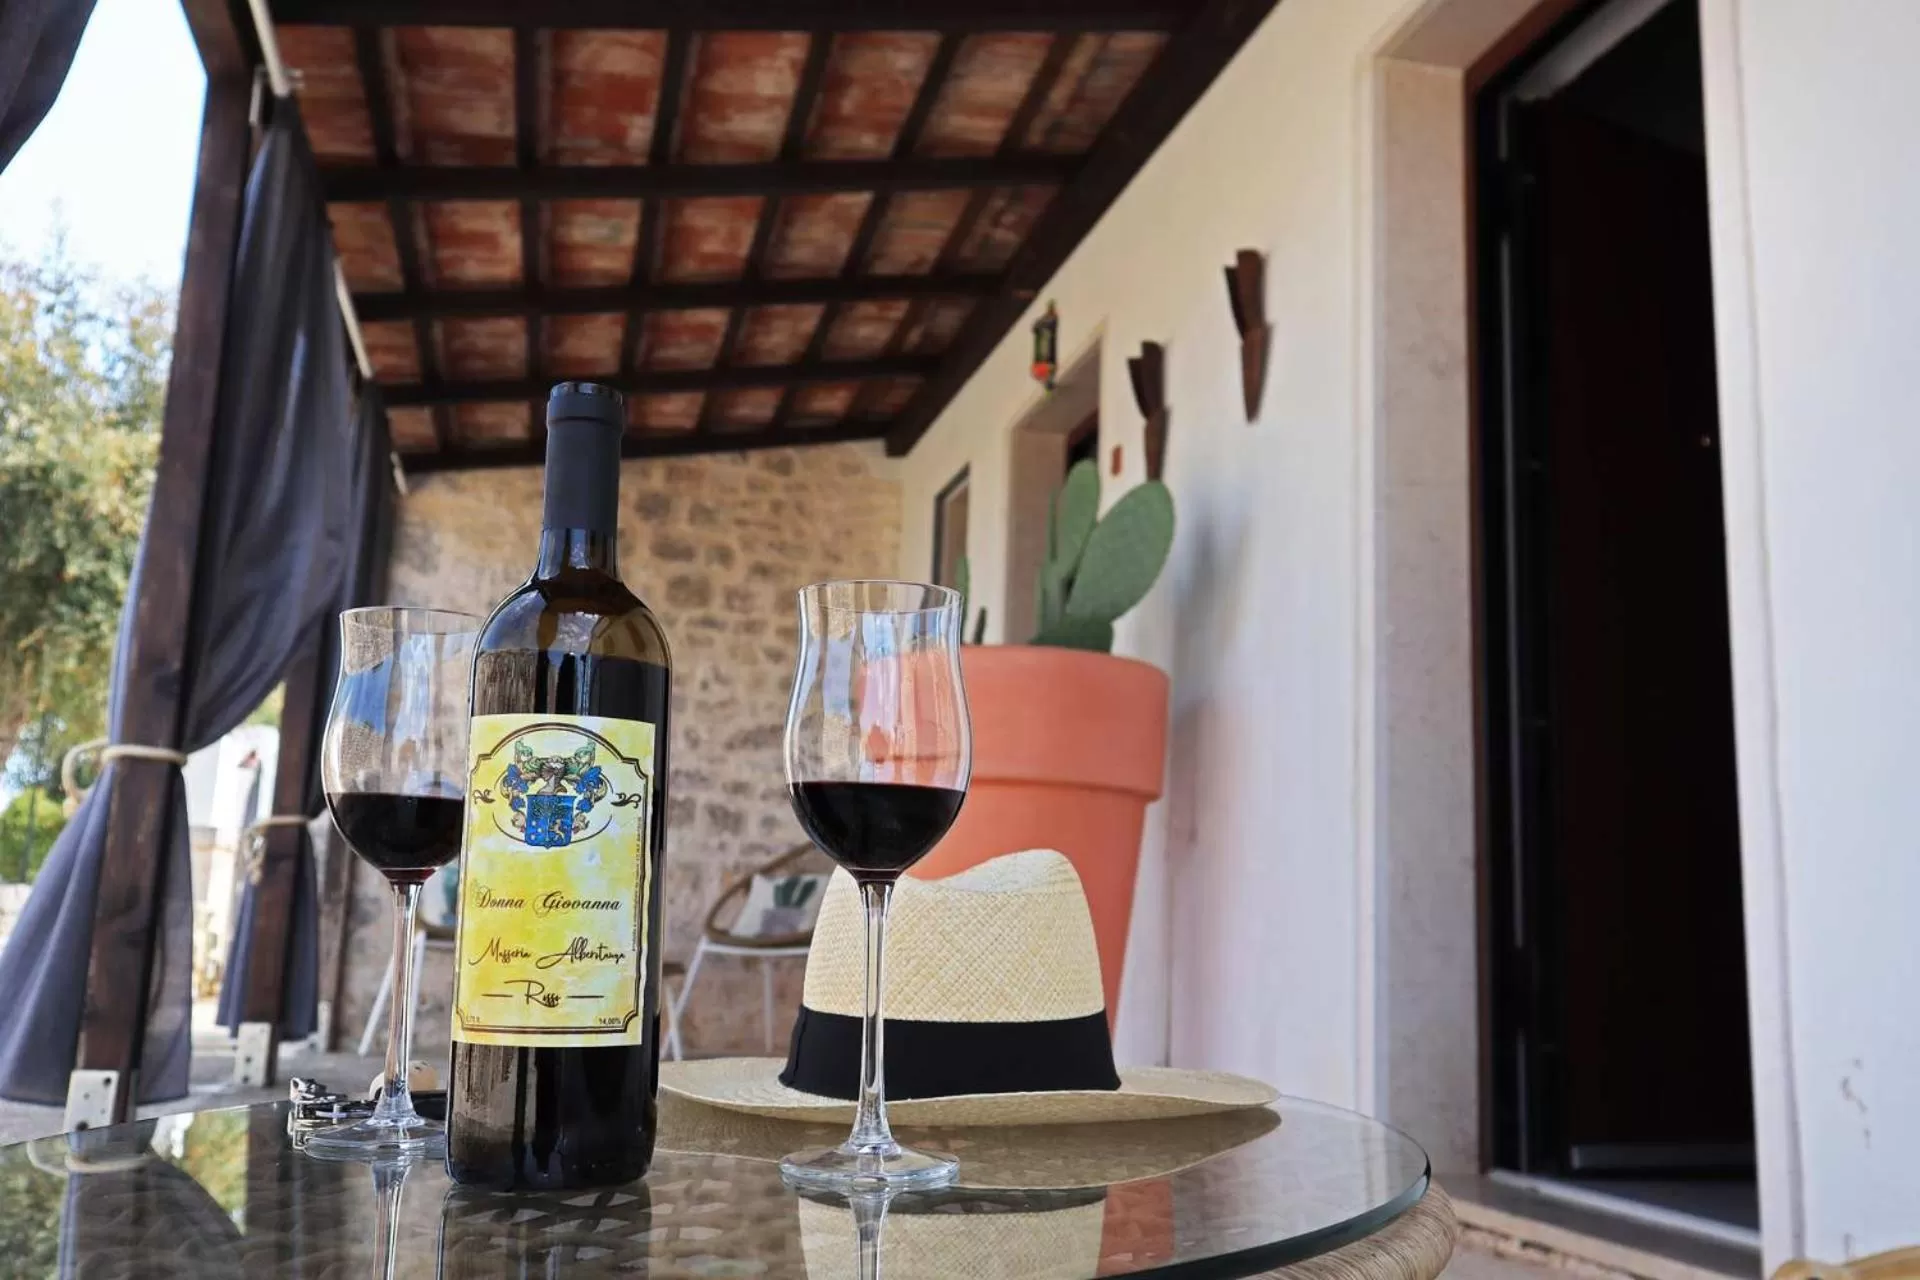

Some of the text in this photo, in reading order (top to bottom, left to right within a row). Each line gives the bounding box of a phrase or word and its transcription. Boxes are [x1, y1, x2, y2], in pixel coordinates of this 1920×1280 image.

[474, 885, 622, 918] Donna Giovanna
[504, 979, 561, 1008] Rosso
